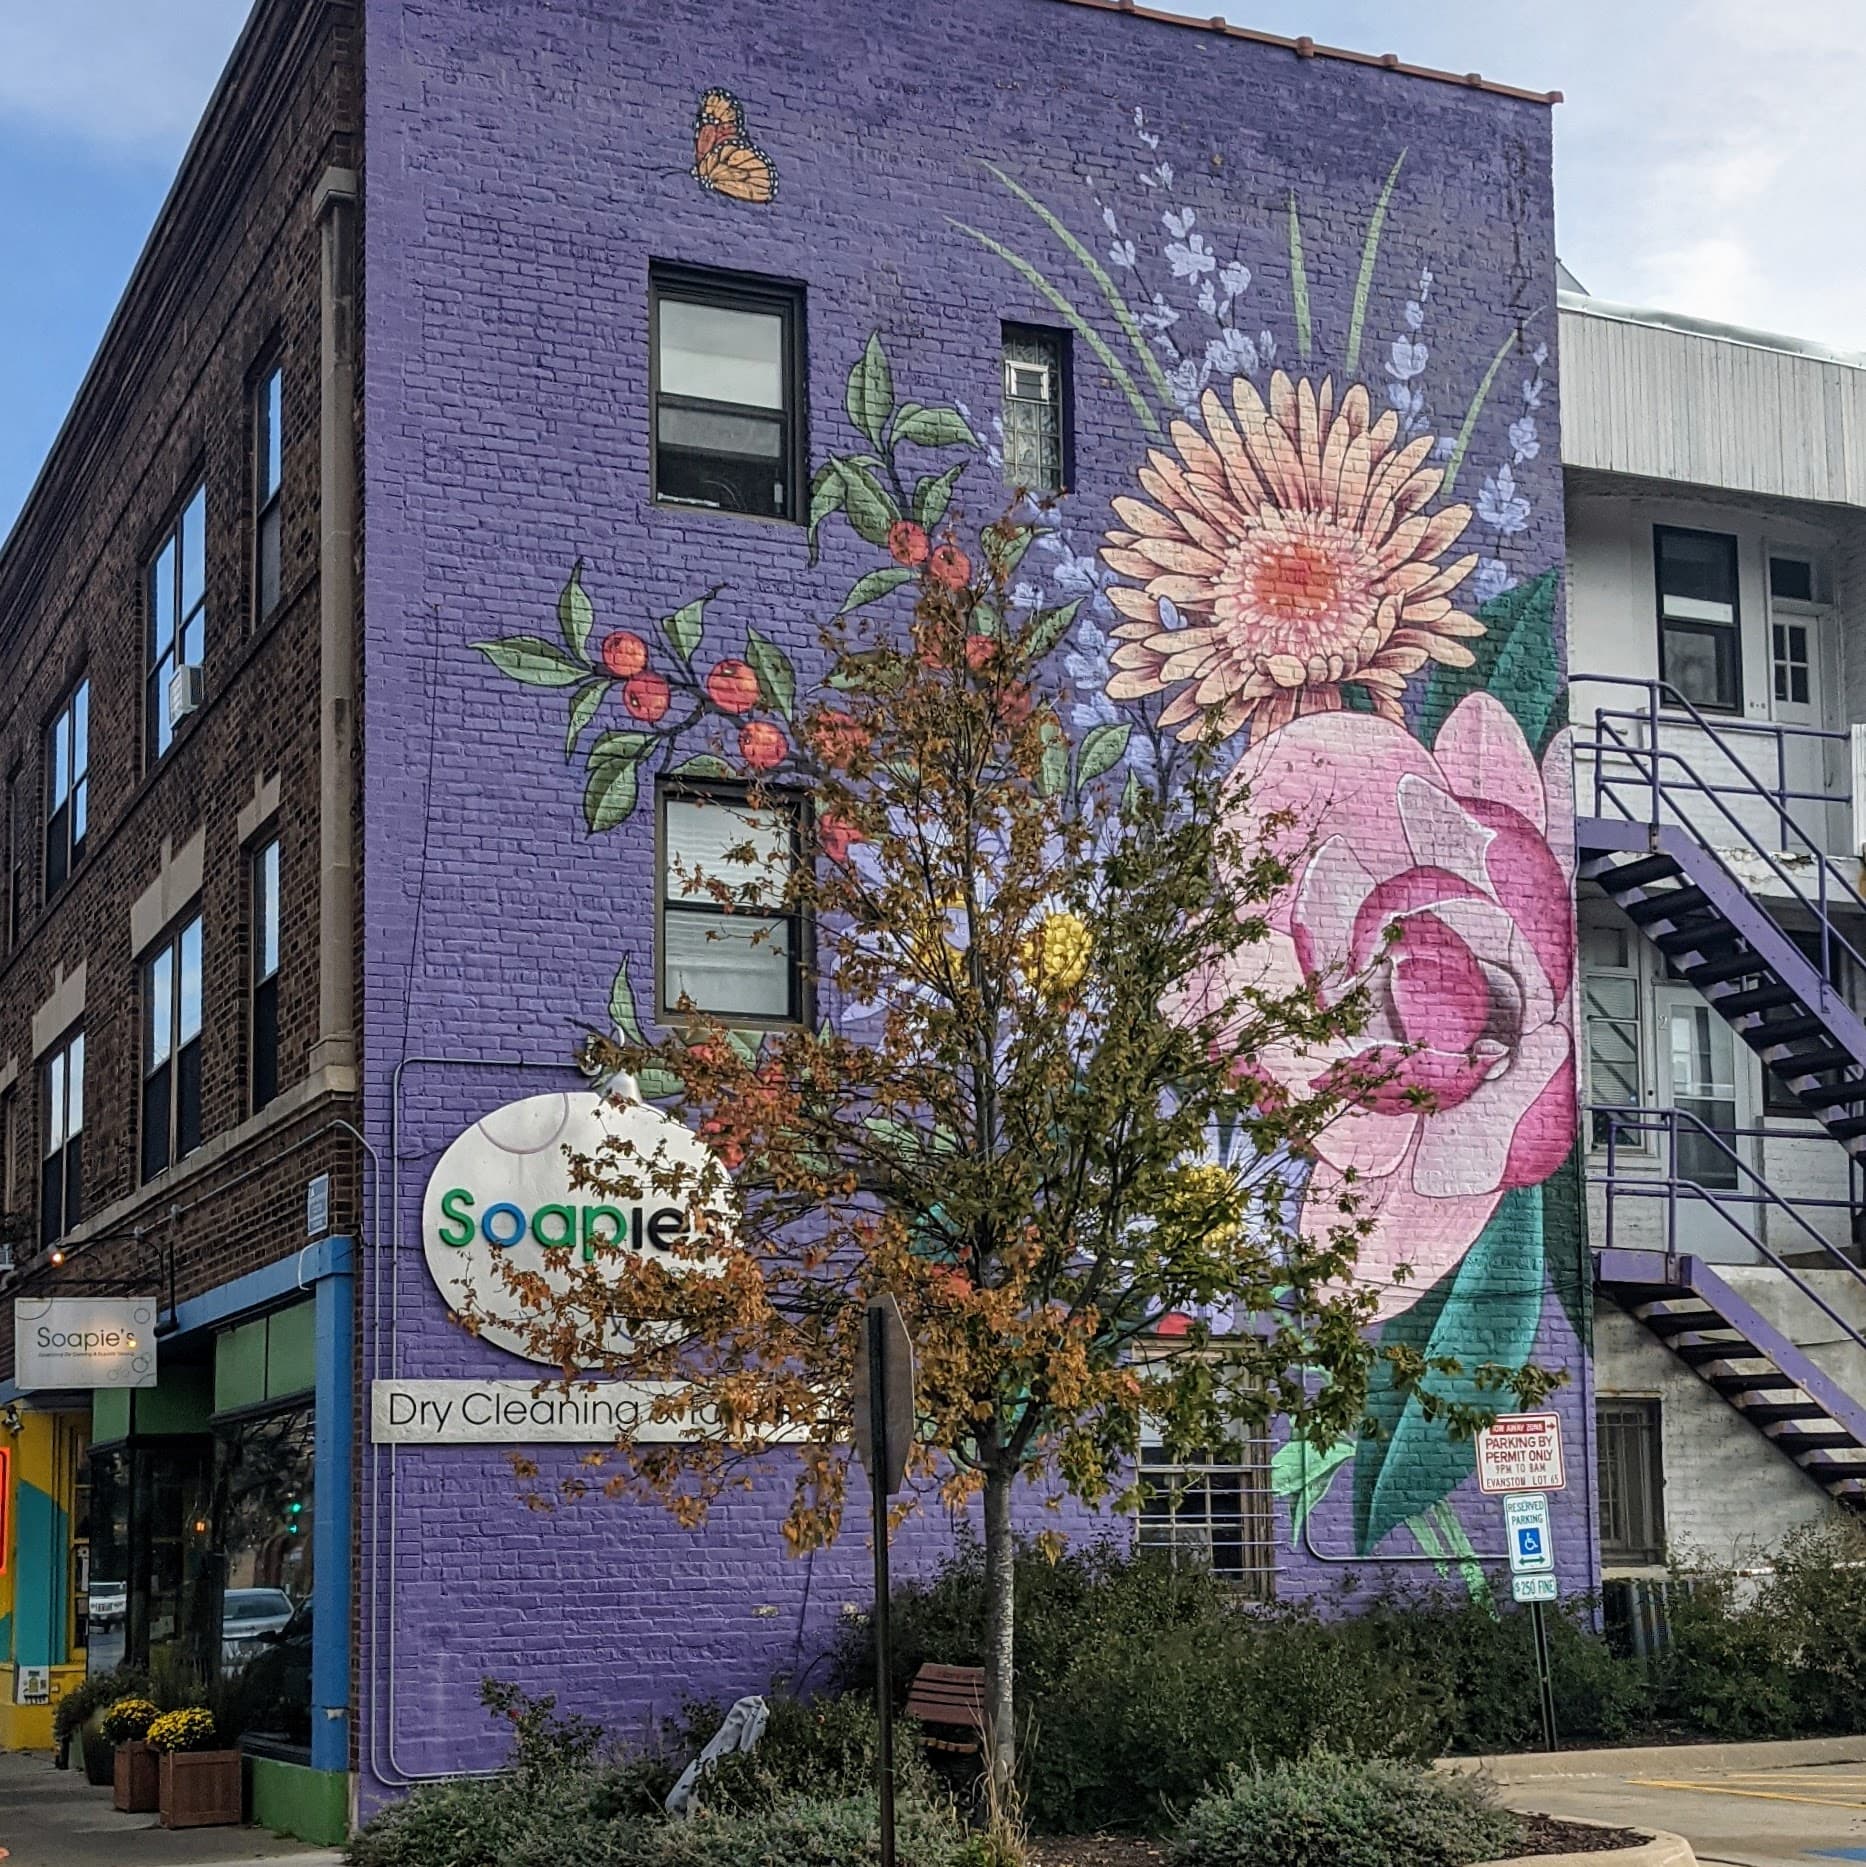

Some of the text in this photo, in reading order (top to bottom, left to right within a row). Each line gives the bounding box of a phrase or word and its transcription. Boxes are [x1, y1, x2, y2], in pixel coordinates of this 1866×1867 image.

[439, 1188, 722, 1261] Soapie
[37, 1326, 135, 1351] Soapie's
[389, 1392, 453, 1433] Dry
[462, 1392, 639, 1432] Cleaning
[1485, 1435, 1553, 1450] PARKING BY
[1485, 1449, 1553, 1464] PERMIT ONLY
[1516, 1463, 1526, 1473] TO
[1486, 1476, 1526, 1489] EVANSTON
[1532, 1475, 1547, 1485] LOT
[1507, 1500, 1544, 1513] RESERVED
[1511, 1514, 1544, 1526] PARKING
[1538, 1580, 1555, 1595] FINE
